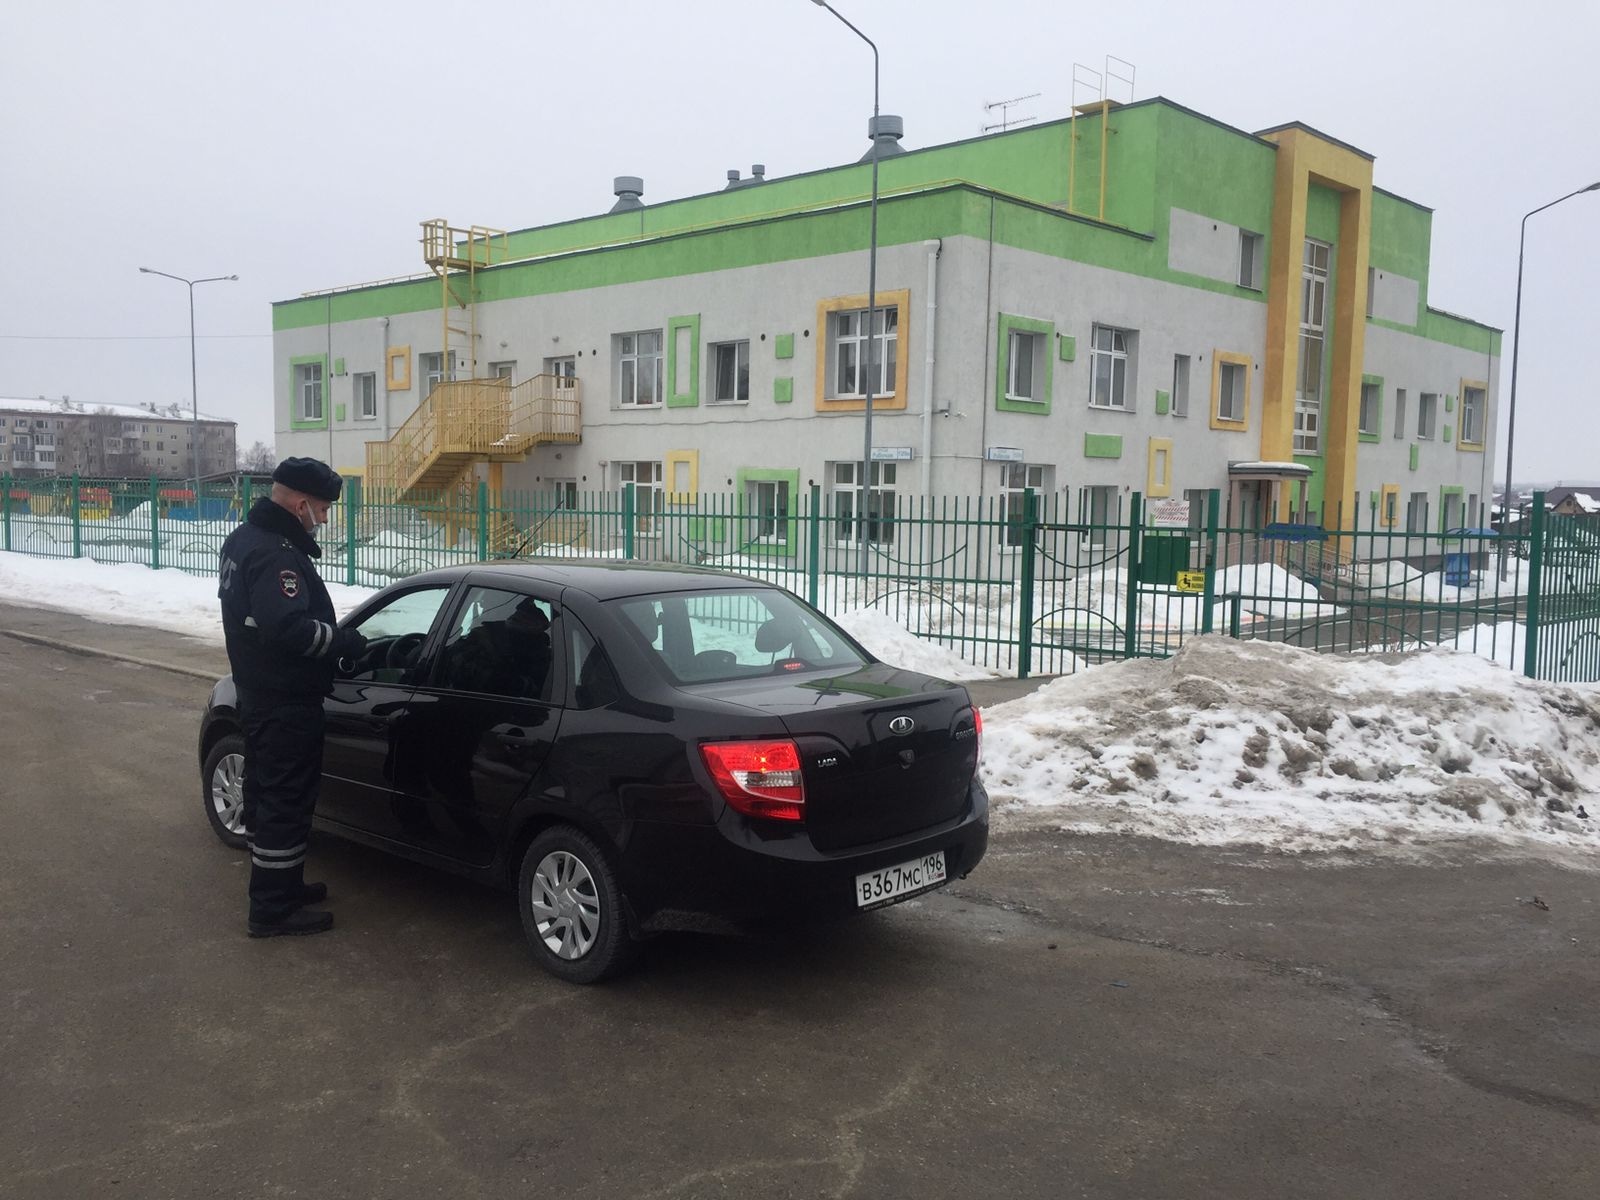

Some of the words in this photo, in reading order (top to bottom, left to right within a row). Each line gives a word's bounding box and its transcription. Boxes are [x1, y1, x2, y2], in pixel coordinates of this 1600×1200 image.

[817, 757, 838, 768] LADA
[862, 867, 921, 901] В367МС
[923, 854, 943, 874] 196
